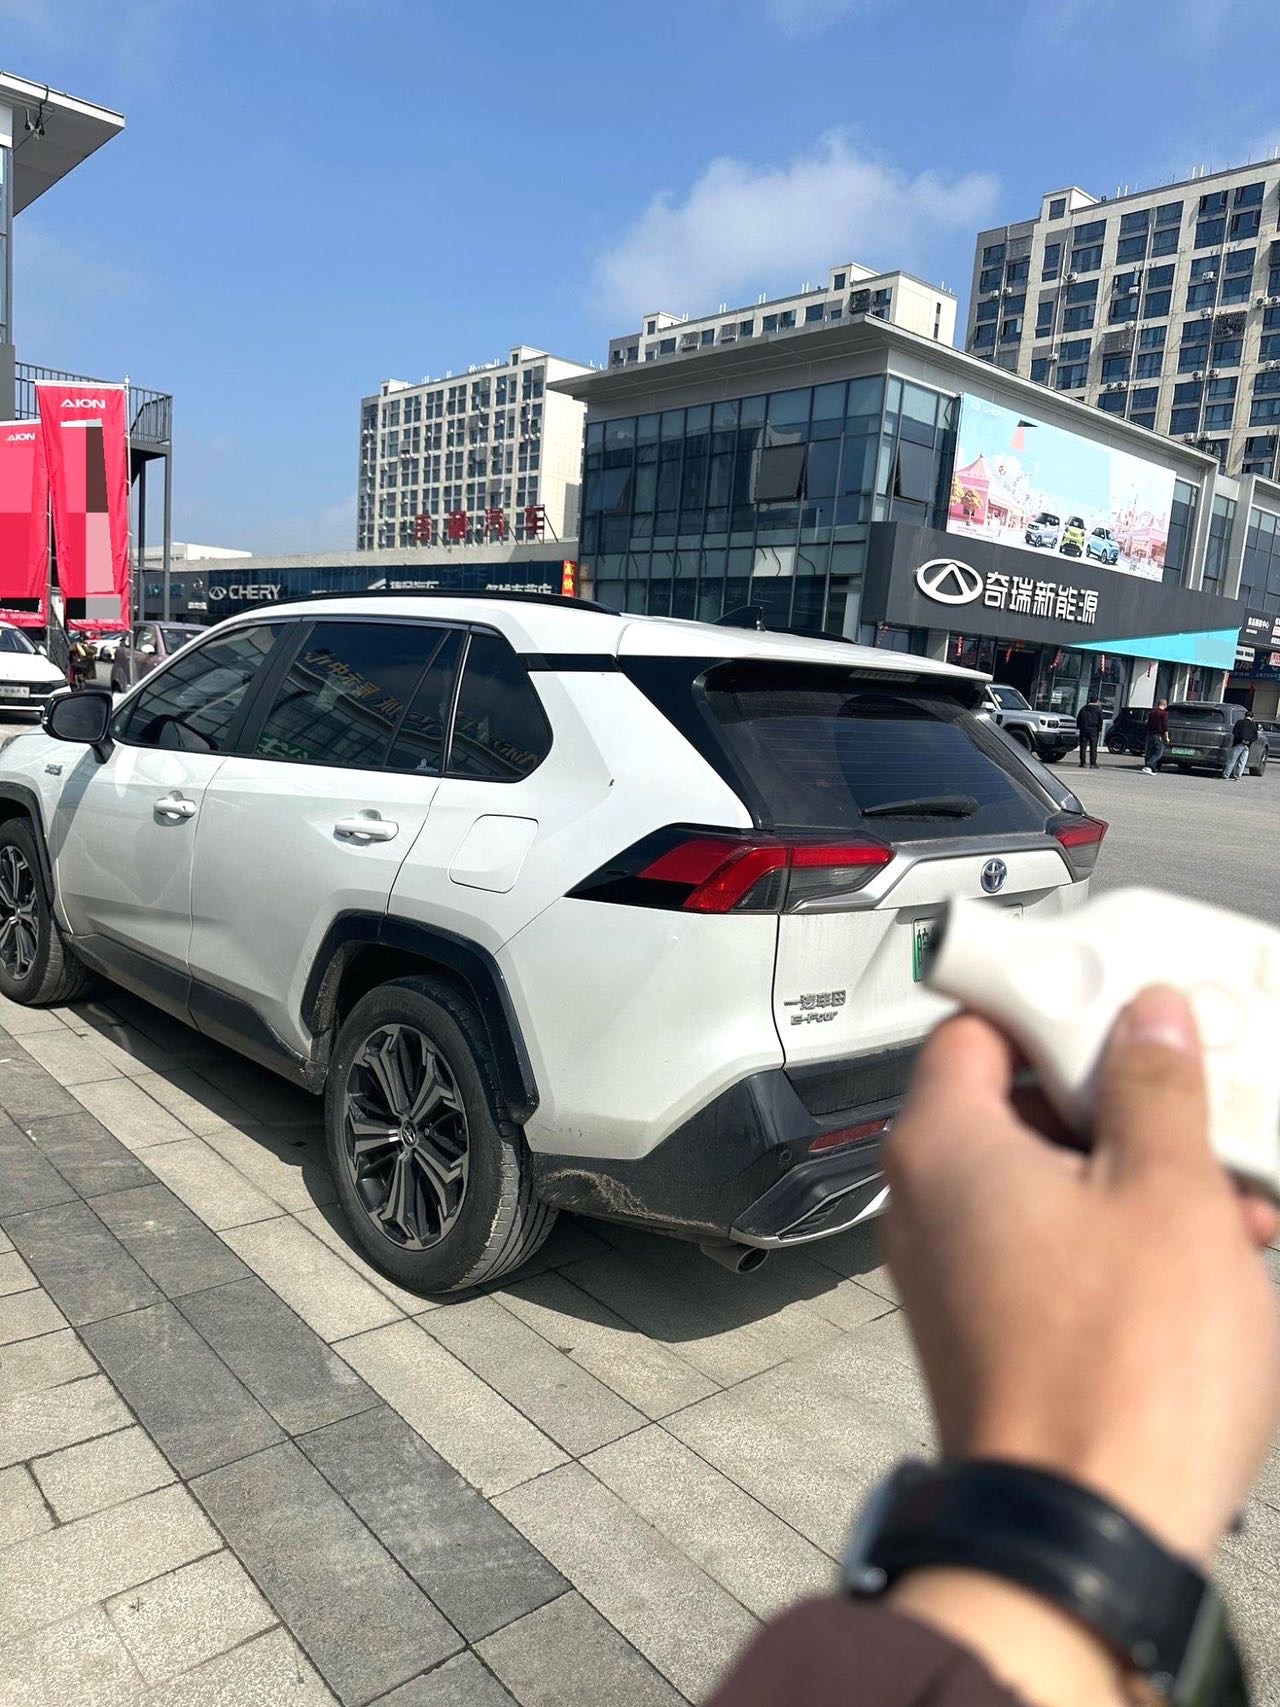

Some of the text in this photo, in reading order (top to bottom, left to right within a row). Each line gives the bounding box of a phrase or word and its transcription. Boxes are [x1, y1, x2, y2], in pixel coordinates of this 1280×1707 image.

[60, 398, 106, 409] AION
[6, 433, 36, 442] AION
[228, 584, 281, 600] CHERY
[984, 571, 1100, 624] 奇瑞新能源
[791, 1011, 838, 1025] E-Four
